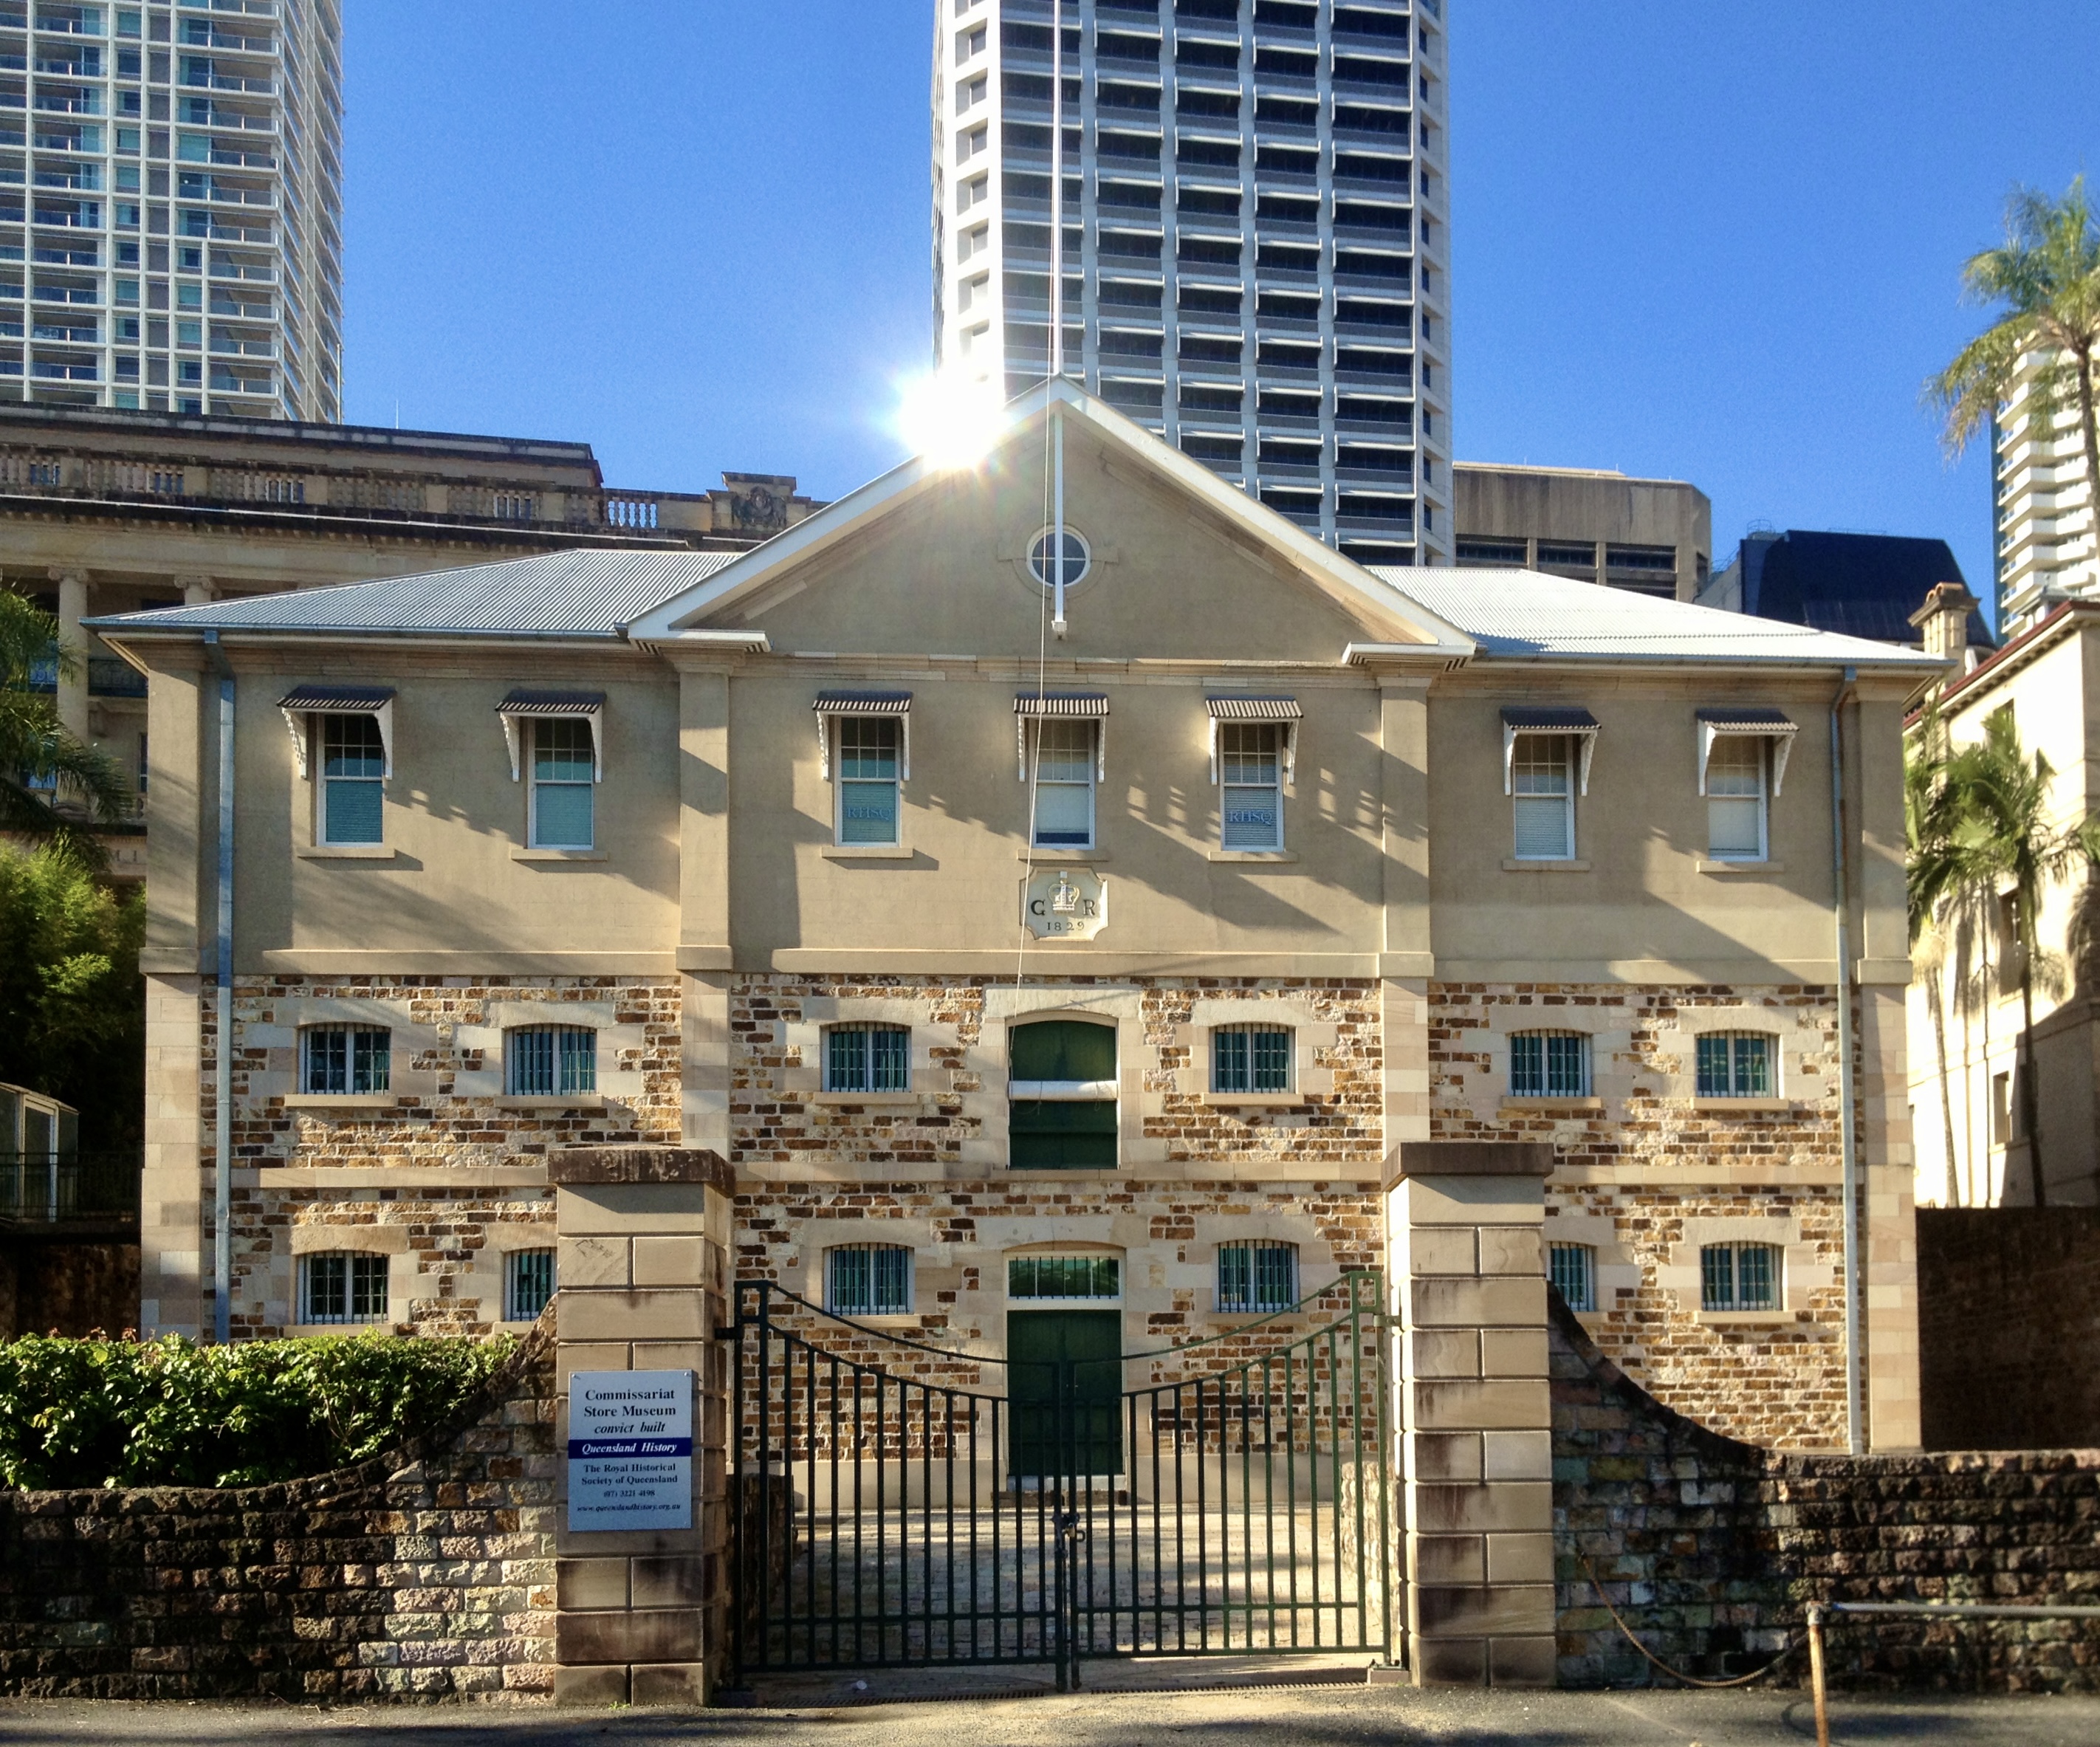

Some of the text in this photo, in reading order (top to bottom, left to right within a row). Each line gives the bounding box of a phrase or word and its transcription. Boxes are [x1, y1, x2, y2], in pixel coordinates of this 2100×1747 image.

[848, 807, 891, 820] RHSQ
[1229, 811, 1273, 826] RHSQ
[1031, 899, 1095, 916] G R
[1046, 921, 1085, 931] 1829
[585, 1388, 675, 1401] Commissariat
[584, 1405, 676, 1417] Store Museum
[594, 1421, 666, 1434] convict built
[582, 1442, 677, 1455] Queensland History
[583, 1463, 676, 1474] The Royal Historical
[581, 1475, 678, 1486] Society of Queensland
